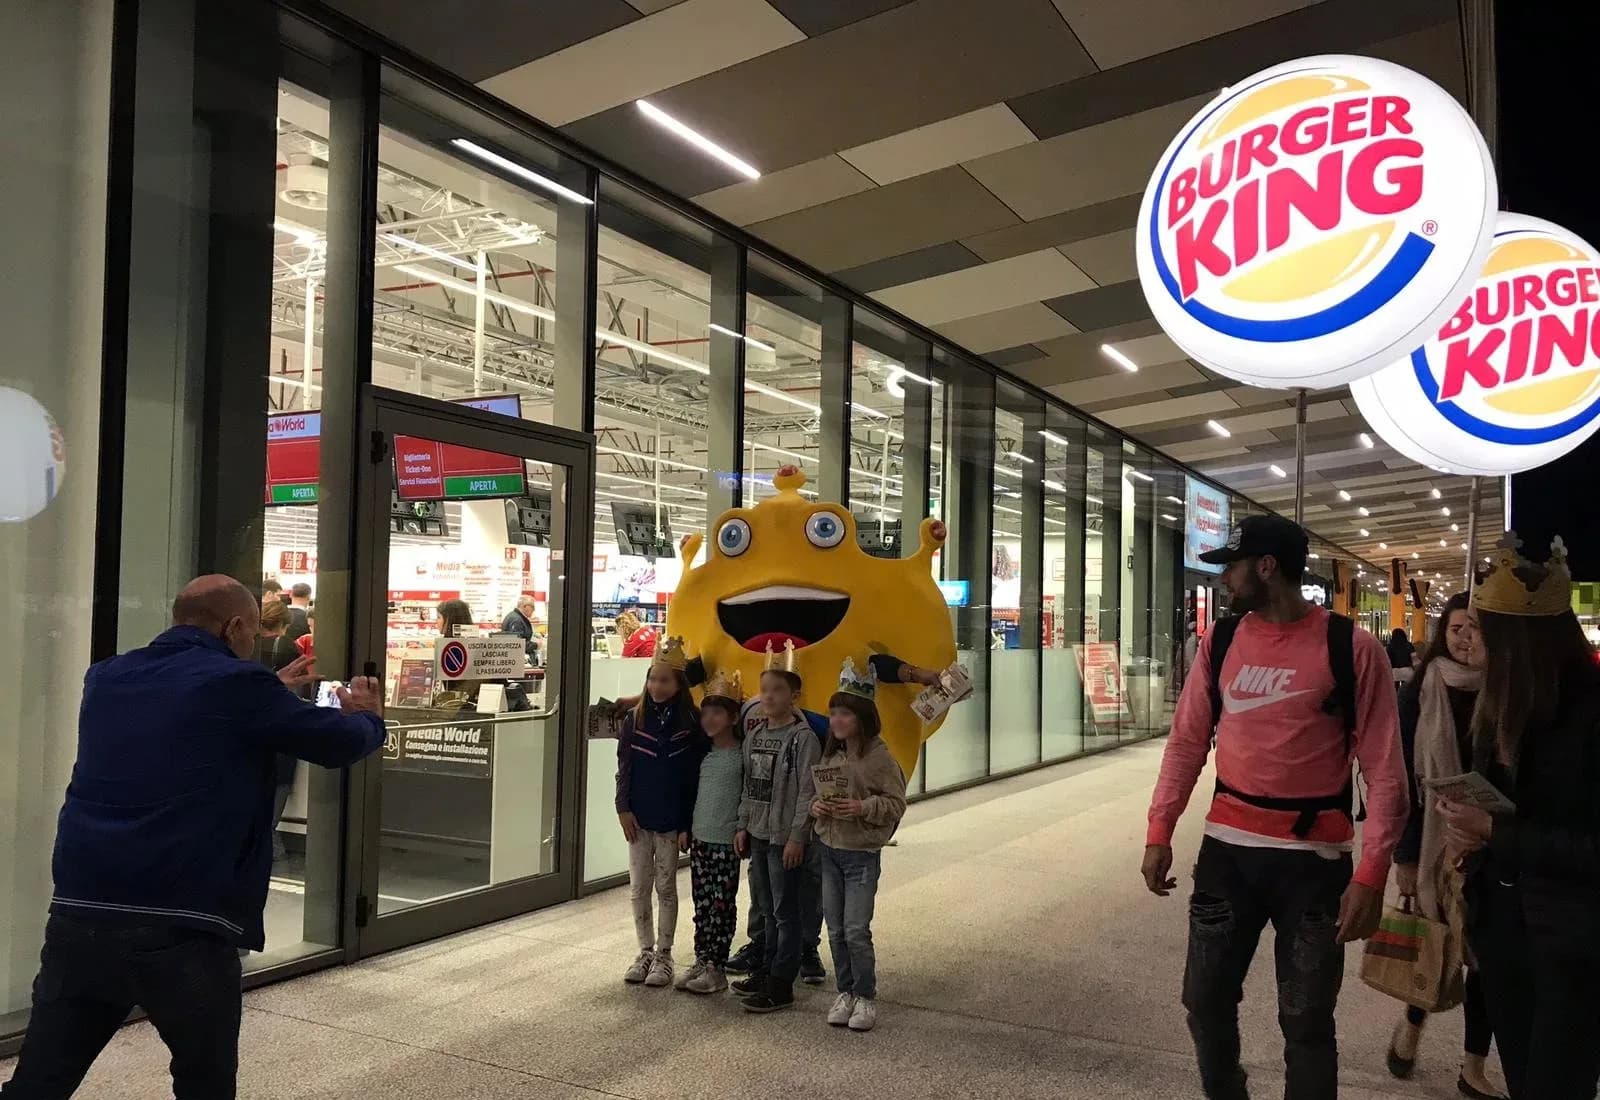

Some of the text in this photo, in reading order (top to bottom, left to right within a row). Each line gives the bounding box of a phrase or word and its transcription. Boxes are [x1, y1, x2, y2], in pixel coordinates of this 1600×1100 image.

[1168, 96, 1413, 229] BURGER
[1176, 138, 1424, 299] KING
[1438, 268, 1600, 341] BURGE
[1441, 308, 1600, 399] KIN
[281, 418, 305, 431] World
[292, 487, 315, 498] APERTA
[469, 480, 497, 491] APERTA
[494, 642, 522, 650] SICUREZZA
[1230, 664, 1297, 697] NIKE
[444, 727, 481, 744] World
[405, 740, 437, 752] Consegna
[438, 744, 443, 752] e
